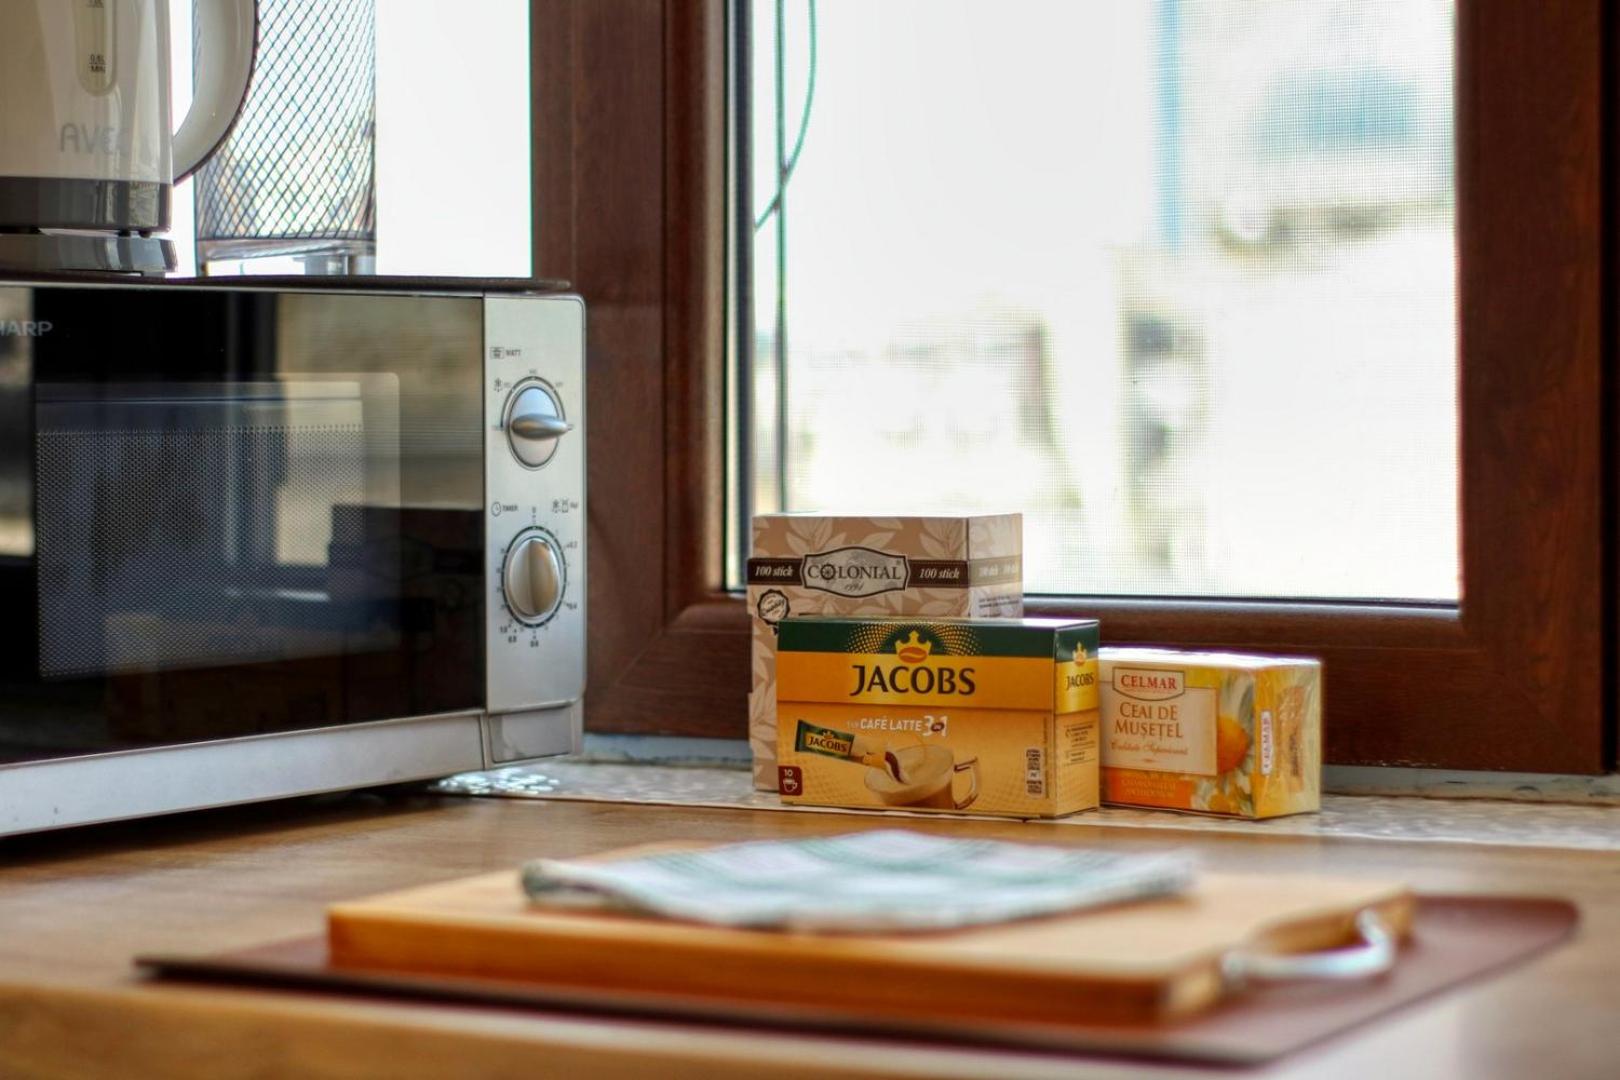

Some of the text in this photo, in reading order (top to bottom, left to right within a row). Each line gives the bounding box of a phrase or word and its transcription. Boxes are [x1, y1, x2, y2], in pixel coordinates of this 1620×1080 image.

[754, 565, 794, 577] 100 stick
[807, 562, 902, 581] COLONIAL
[919, 567, 961, 579] 100 stick
[849, 664, 976, 696] JACOBS
[1065, 671, 1095, 691] JACOBS
[1120, 673, 1178, 691] CELMAR
[1119, 701, 1179, 721] CEAI DE
[860, 715, 888, 730] CAFÉ
[889, 718, 923, 733] LATTE
[808, 735, 848, 753] JACOBS
[784, 768, 794, 777] 10
